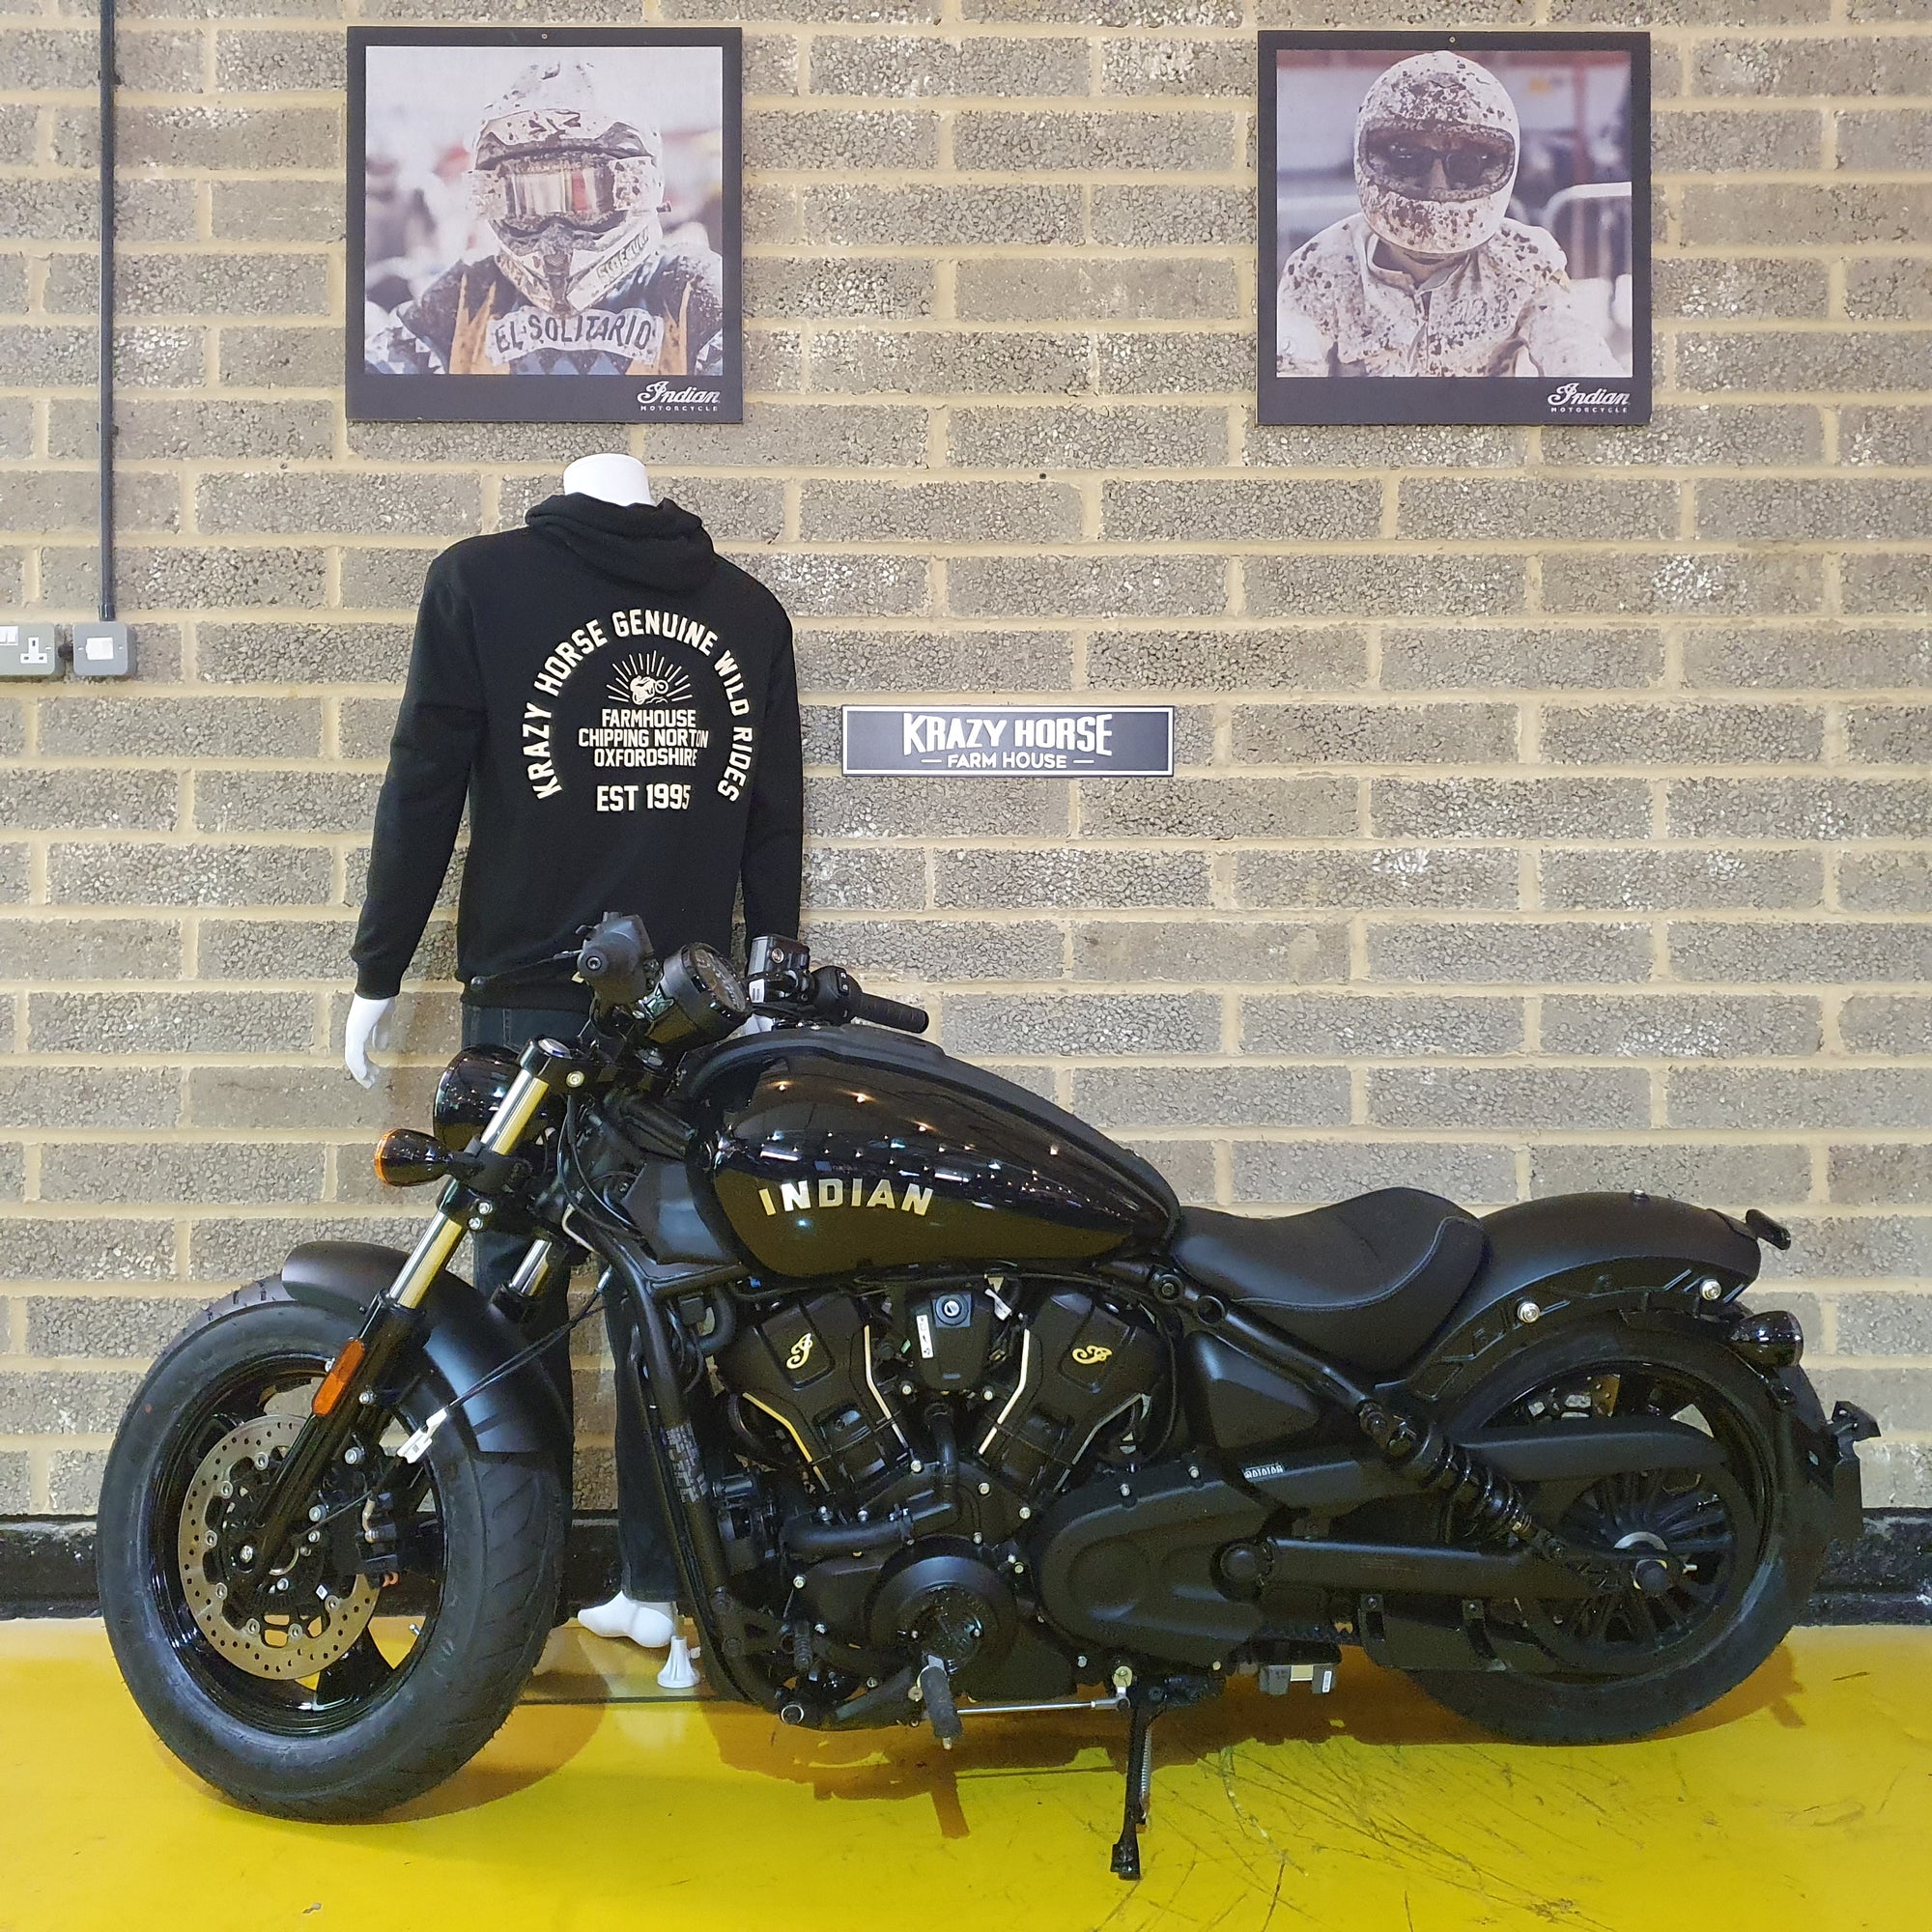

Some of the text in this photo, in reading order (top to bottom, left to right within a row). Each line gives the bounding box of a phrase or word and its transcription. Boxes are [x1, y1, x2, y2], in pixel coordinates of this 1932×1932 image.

[495, 314, 651, 354] EL SOLITARIO
[638, 381, 721, 404] Indian
[1548, 383, 1631, 406] Indian
[522, 609, 753, 802] KRAZY HORSE GENUINE WILD RIDES
[601, 708, 697, 728] FARMHOUSE
[578, 727, 709, 749] CHIPPING NORTON
[903, 712, 1113, 756] KRAZY HORSE
[594, 748, 698, 768] OXFORDSHIRE
[947, 753, 1067, 769] FARM HOUSE
[596, 783, 692, 812] EST 1995
[758, 1178, 933, 1216] INDIAN
